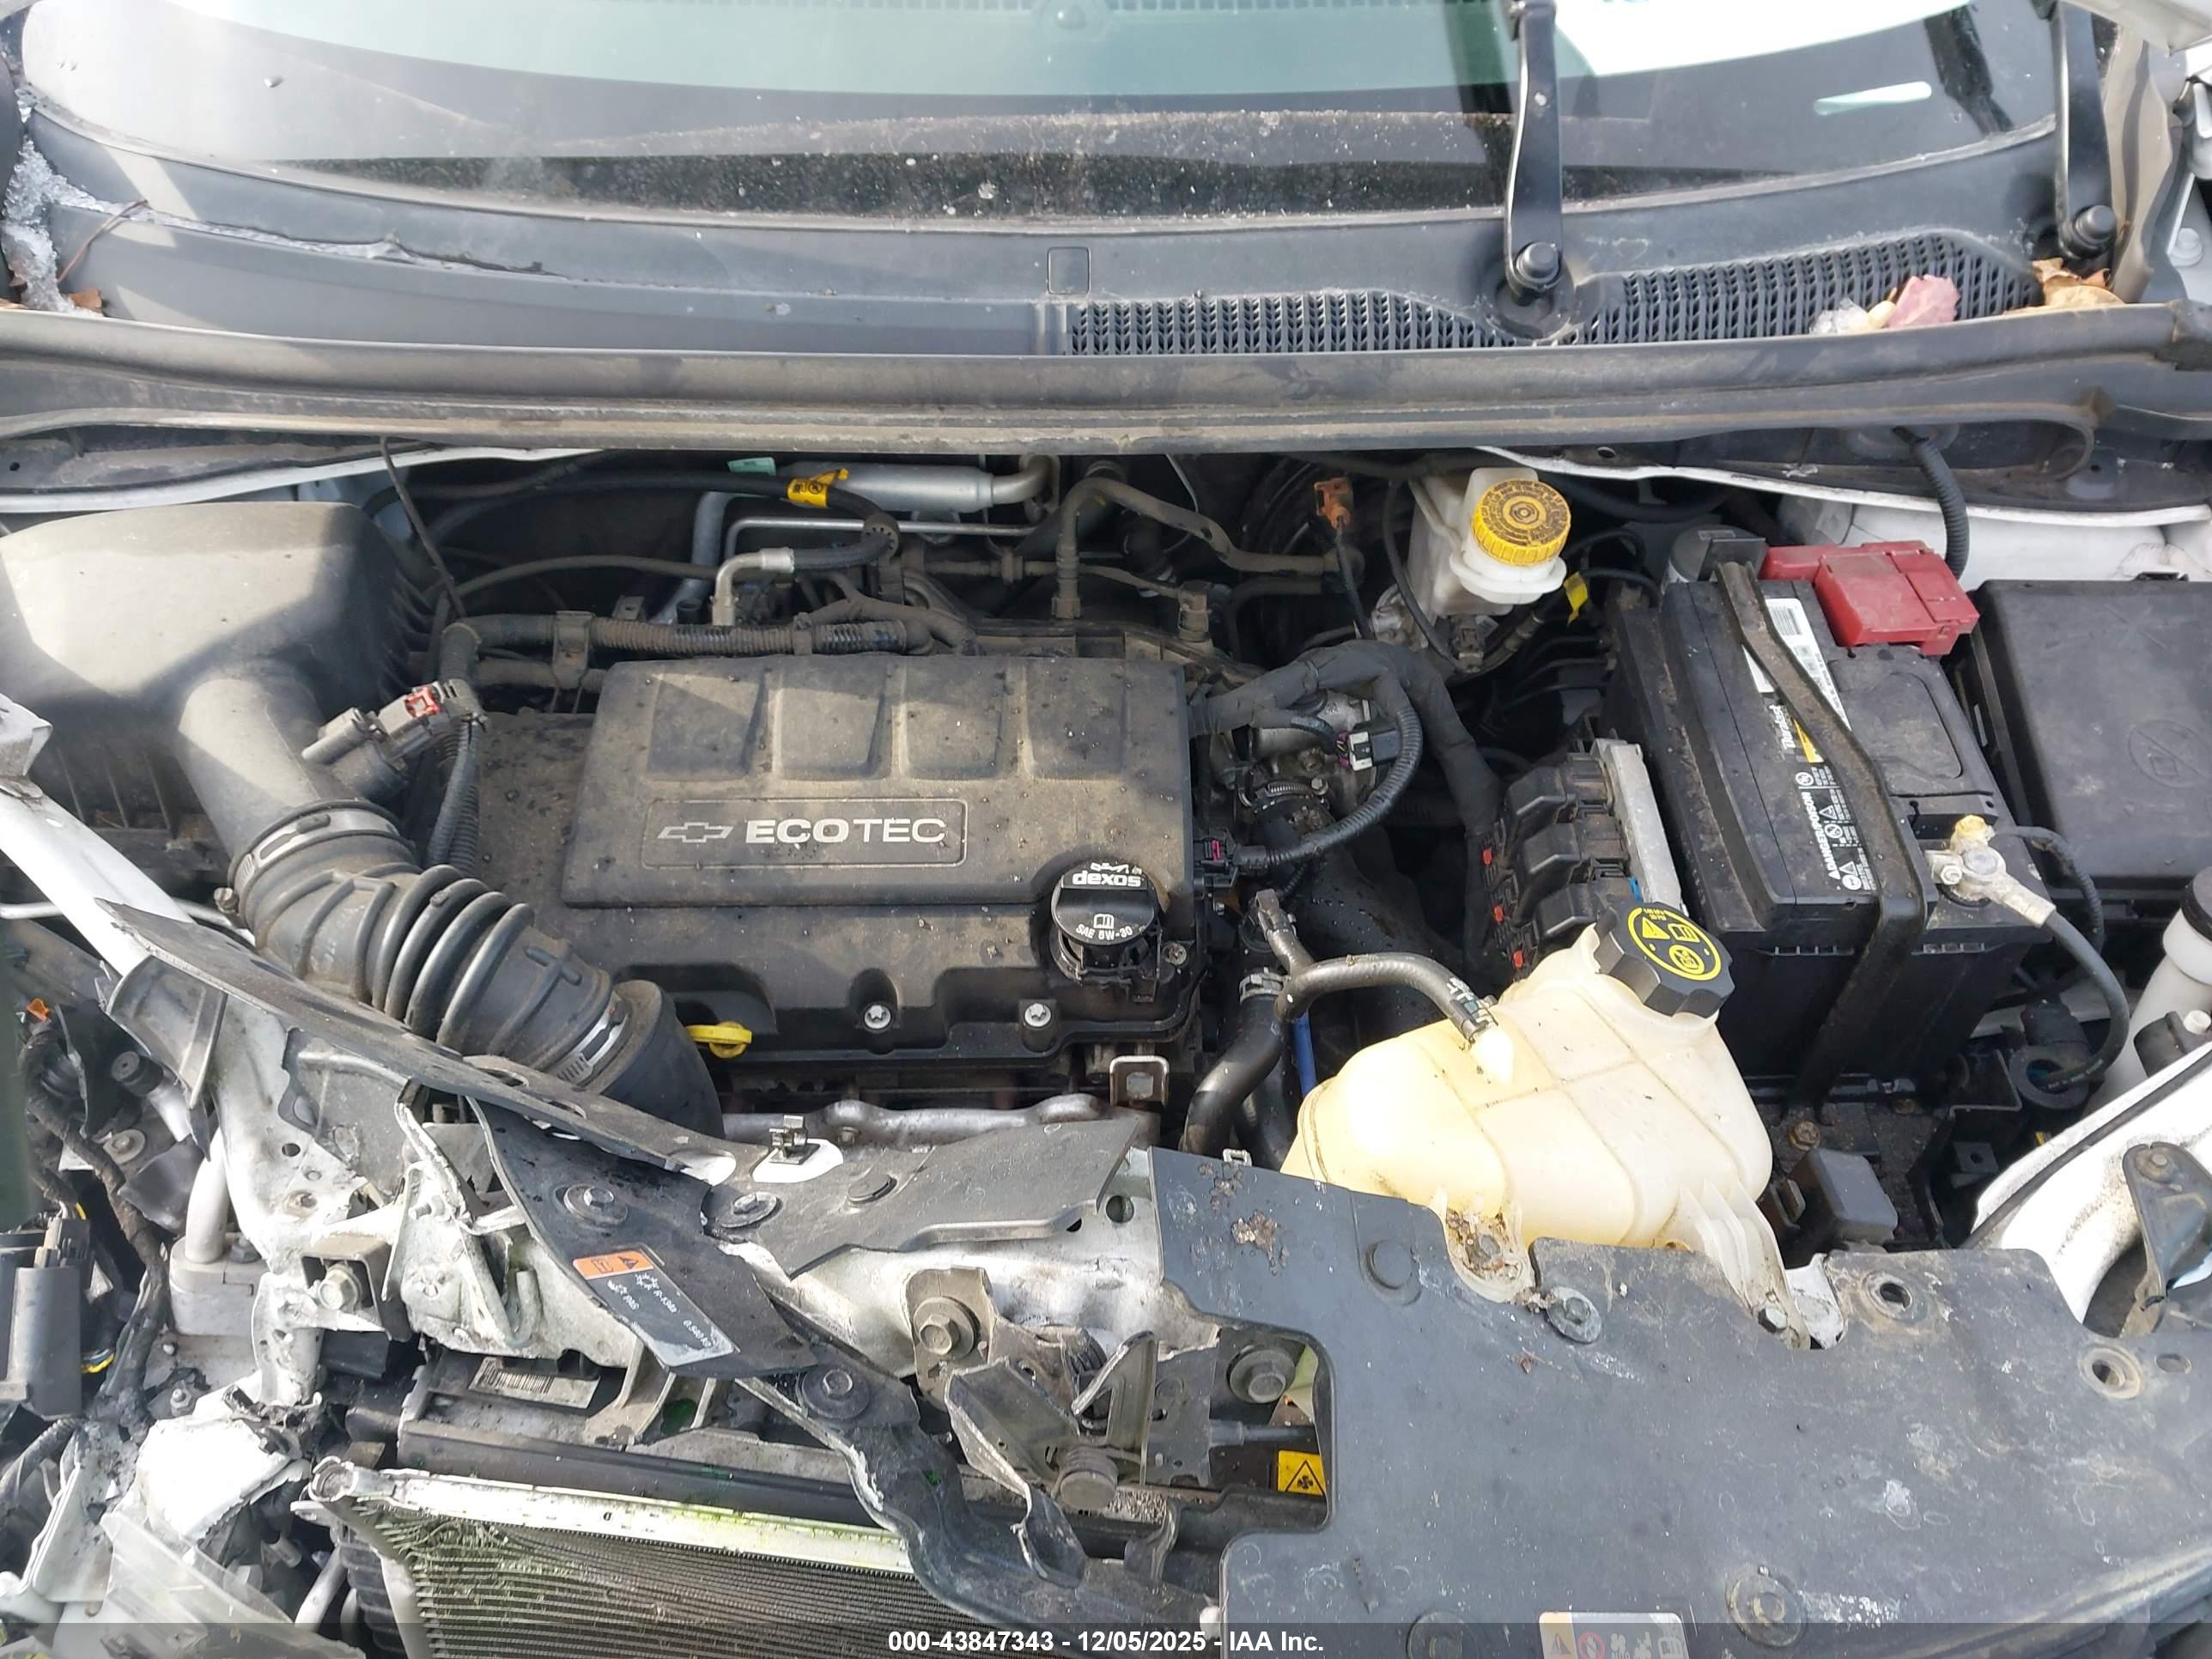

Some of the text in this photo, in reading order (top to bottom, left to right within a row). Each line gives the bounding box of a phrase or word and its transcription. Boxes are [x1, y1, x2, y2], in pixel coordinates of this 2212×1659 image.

[745, 818, 946, 843] ECOTEC
[1801, 791, 1838, 871] DANGER/POISON
[1072, 870, 1142, 888] dexos
[1075, 923, 1133, 940] SAE 5W-30
